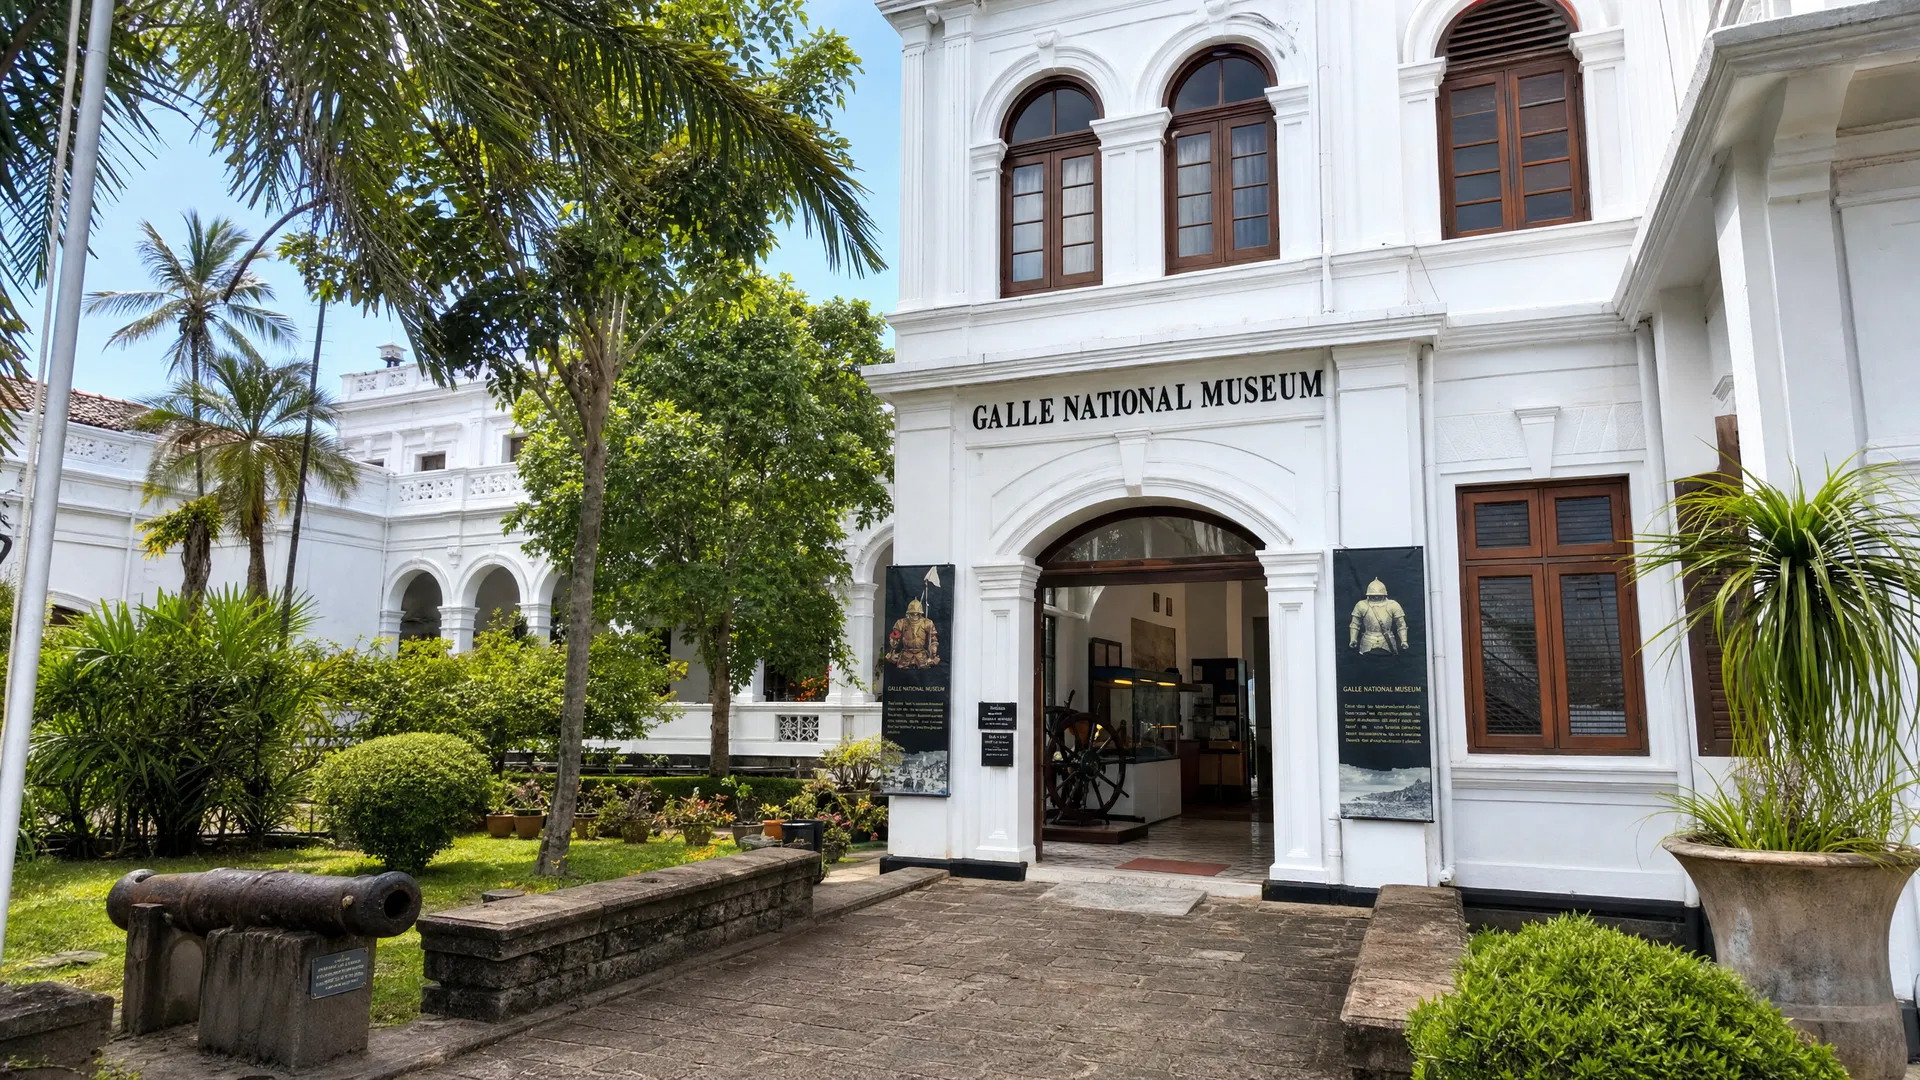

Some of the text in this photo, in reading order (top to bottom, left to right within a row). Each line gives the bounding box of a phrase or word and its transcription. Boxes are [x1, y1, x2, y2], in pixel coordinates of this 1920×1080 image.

[972, 369, 1324, 430] GALLE NATIONAL MUSEUM
